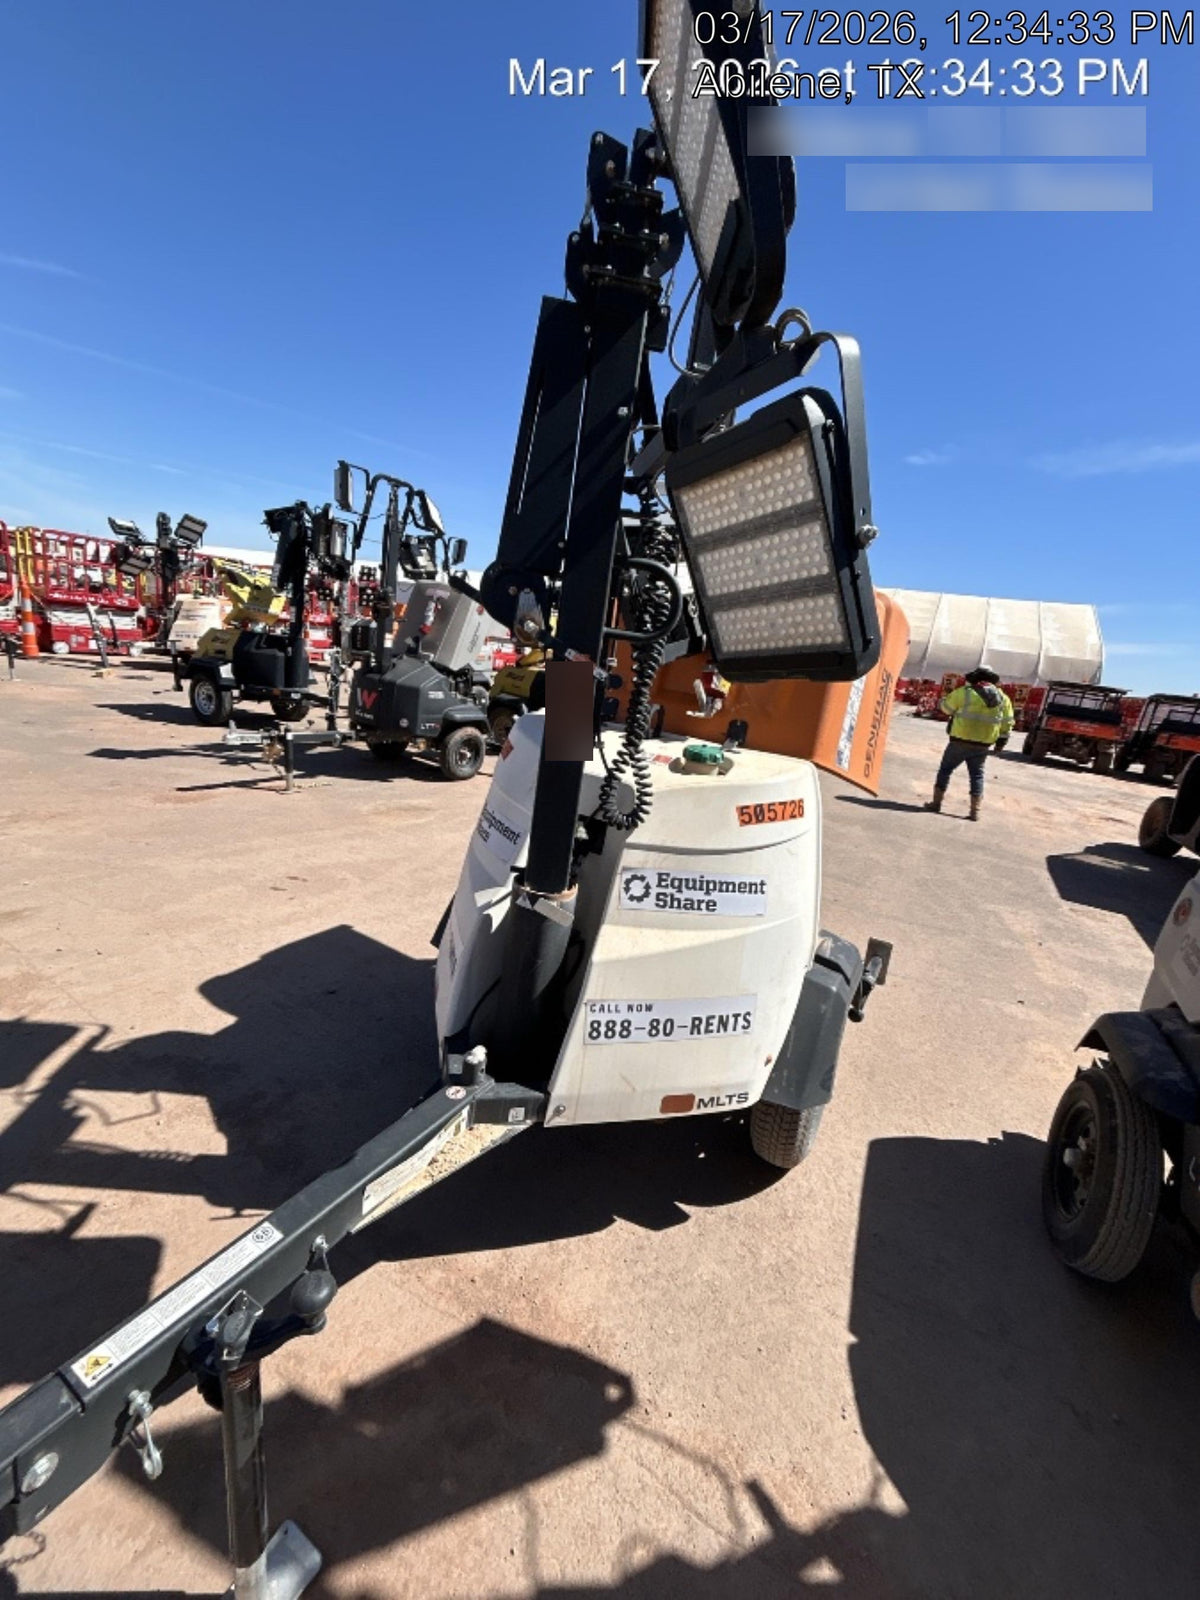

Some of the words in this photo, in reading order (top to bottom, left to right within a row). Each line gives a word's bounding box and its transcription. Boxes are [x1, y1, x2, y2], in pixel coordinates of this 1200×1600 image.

[738, 799, 804, 825] 505726
[655, 872, 766, 896] Equipment
[654, 892, 718, 913] Share
[589, 1003, 621, 1014] CALL
[627, 1003, 653, 1013] NOW
[588, 1010, 752, 1040] 888-80-RENTS
[696, 1092, 750, 1110] MLTS
